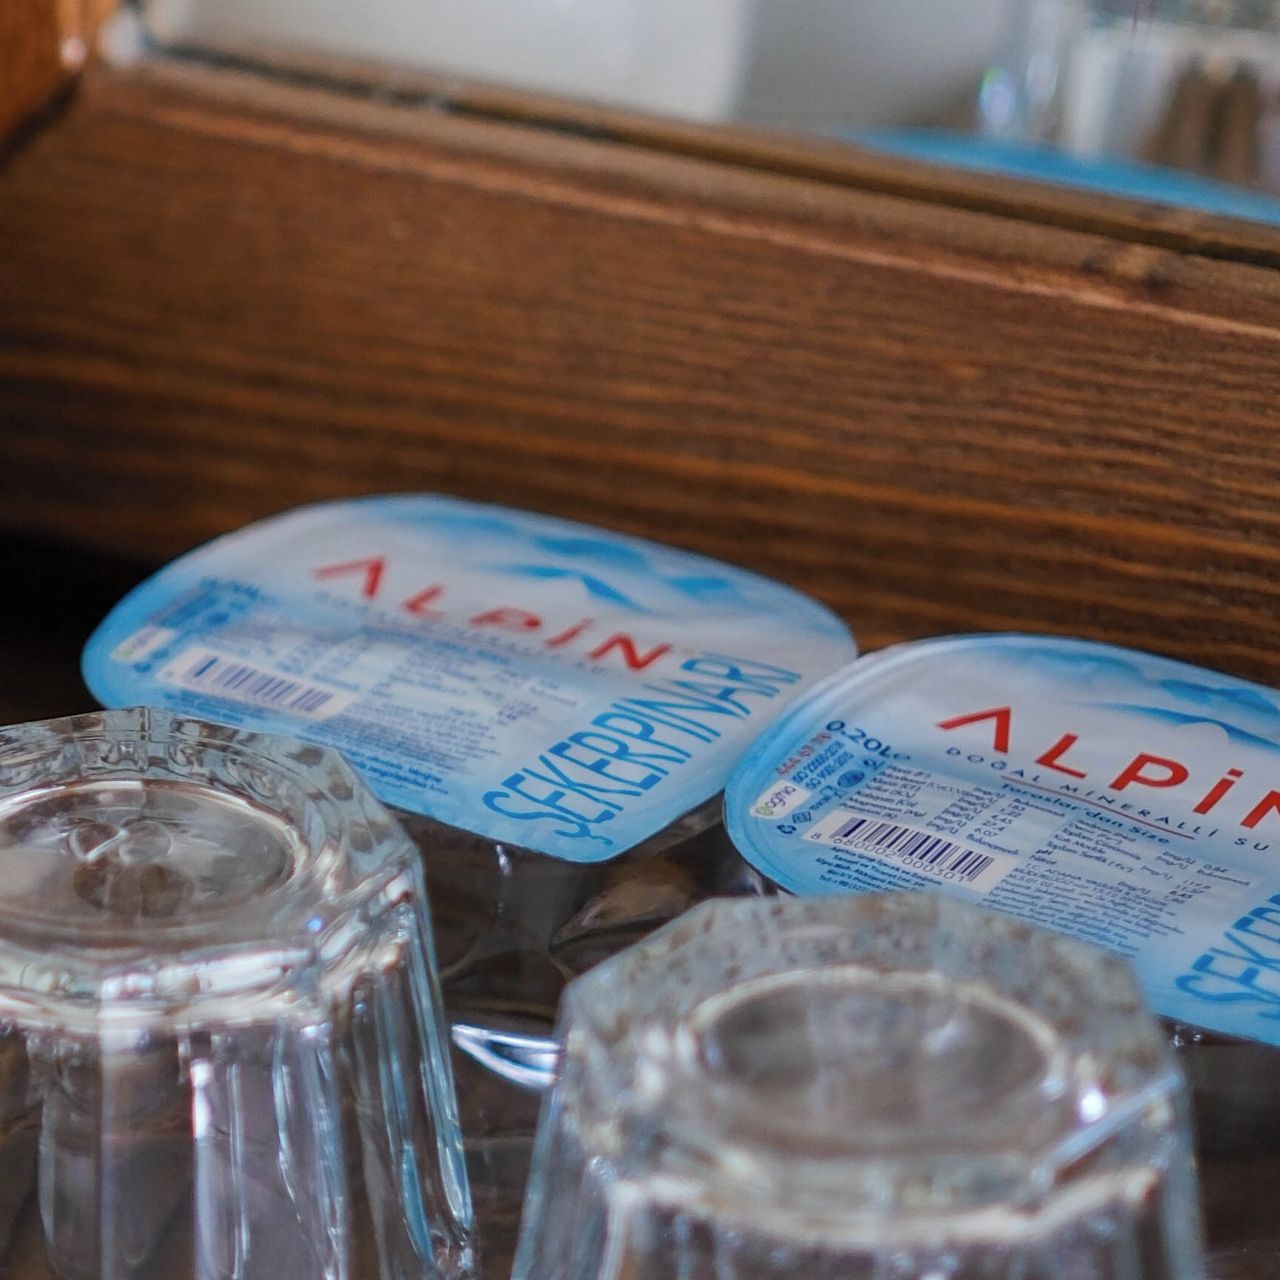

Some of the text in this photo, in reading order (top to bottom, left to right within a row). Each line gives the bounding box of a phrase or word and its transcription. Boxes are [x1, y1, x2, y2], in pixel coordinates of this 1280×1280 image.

[946, 747, 1041, 782] DOĞAL
[1234, 837, 1270, 851] SU
[1130, 826, 1170, 844] Size
